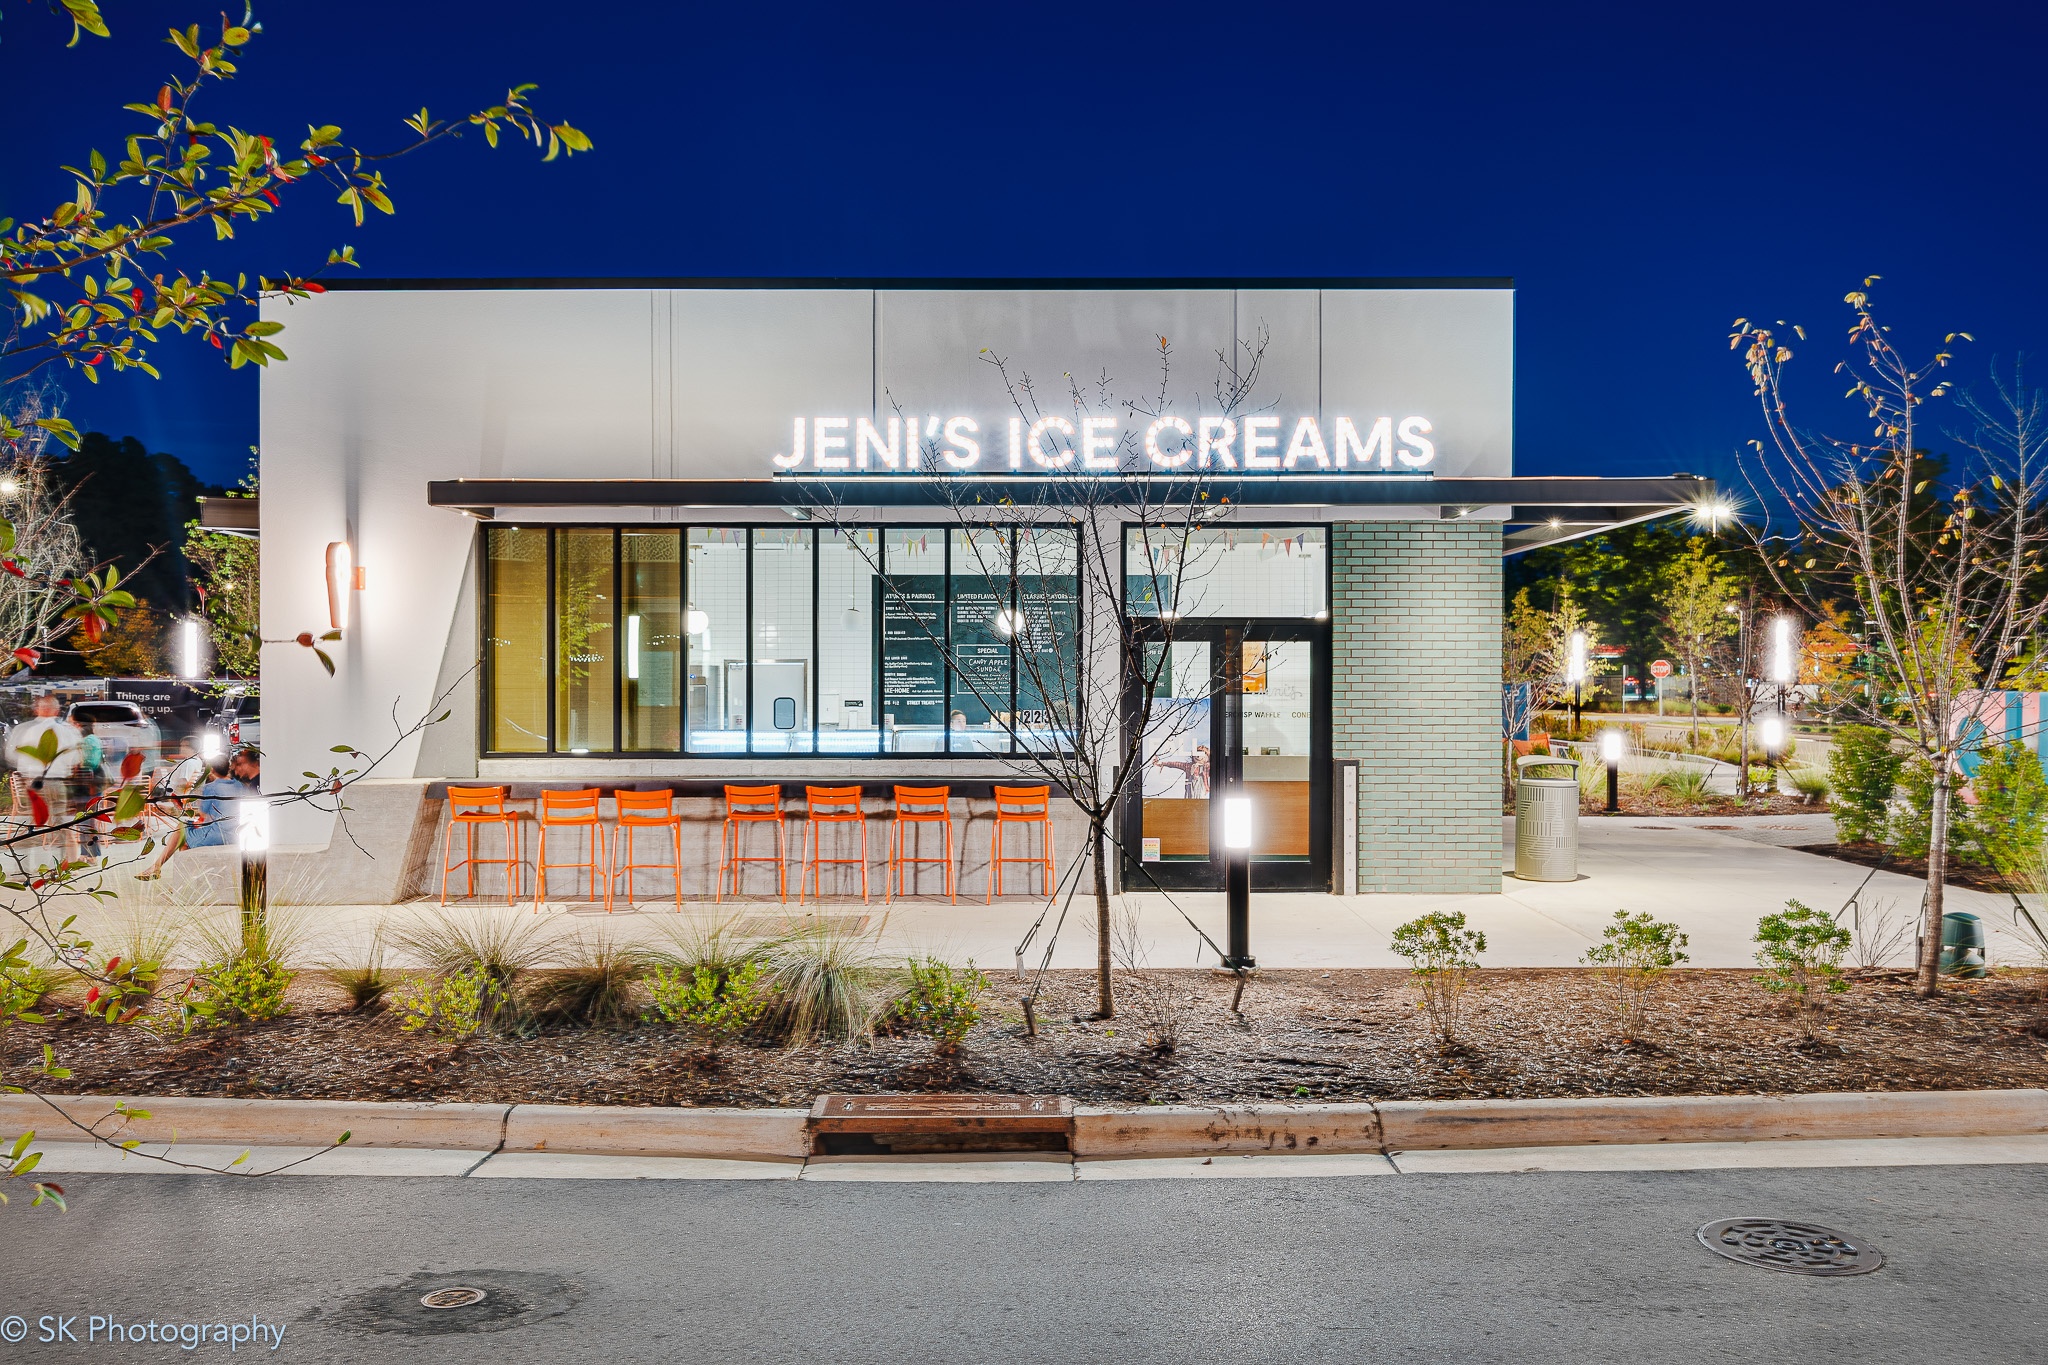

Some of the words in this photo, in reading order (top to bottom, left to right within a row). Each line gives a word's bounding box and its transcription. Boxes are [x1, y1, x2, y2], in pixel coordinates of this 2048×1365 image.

[772, 415, 980, 469] JENI'S
[1008, 415, 1119, 469] ICE
[1145, 415, 1436, 469] CREAMS
[1652, 665, 1668, 673] STOP
[115, 691, 150, 702] Things
[153, 694, 171, 702] are
[156, 705, 173, 715] up.
[1254, 711, 1281, 719] WAFFLE
